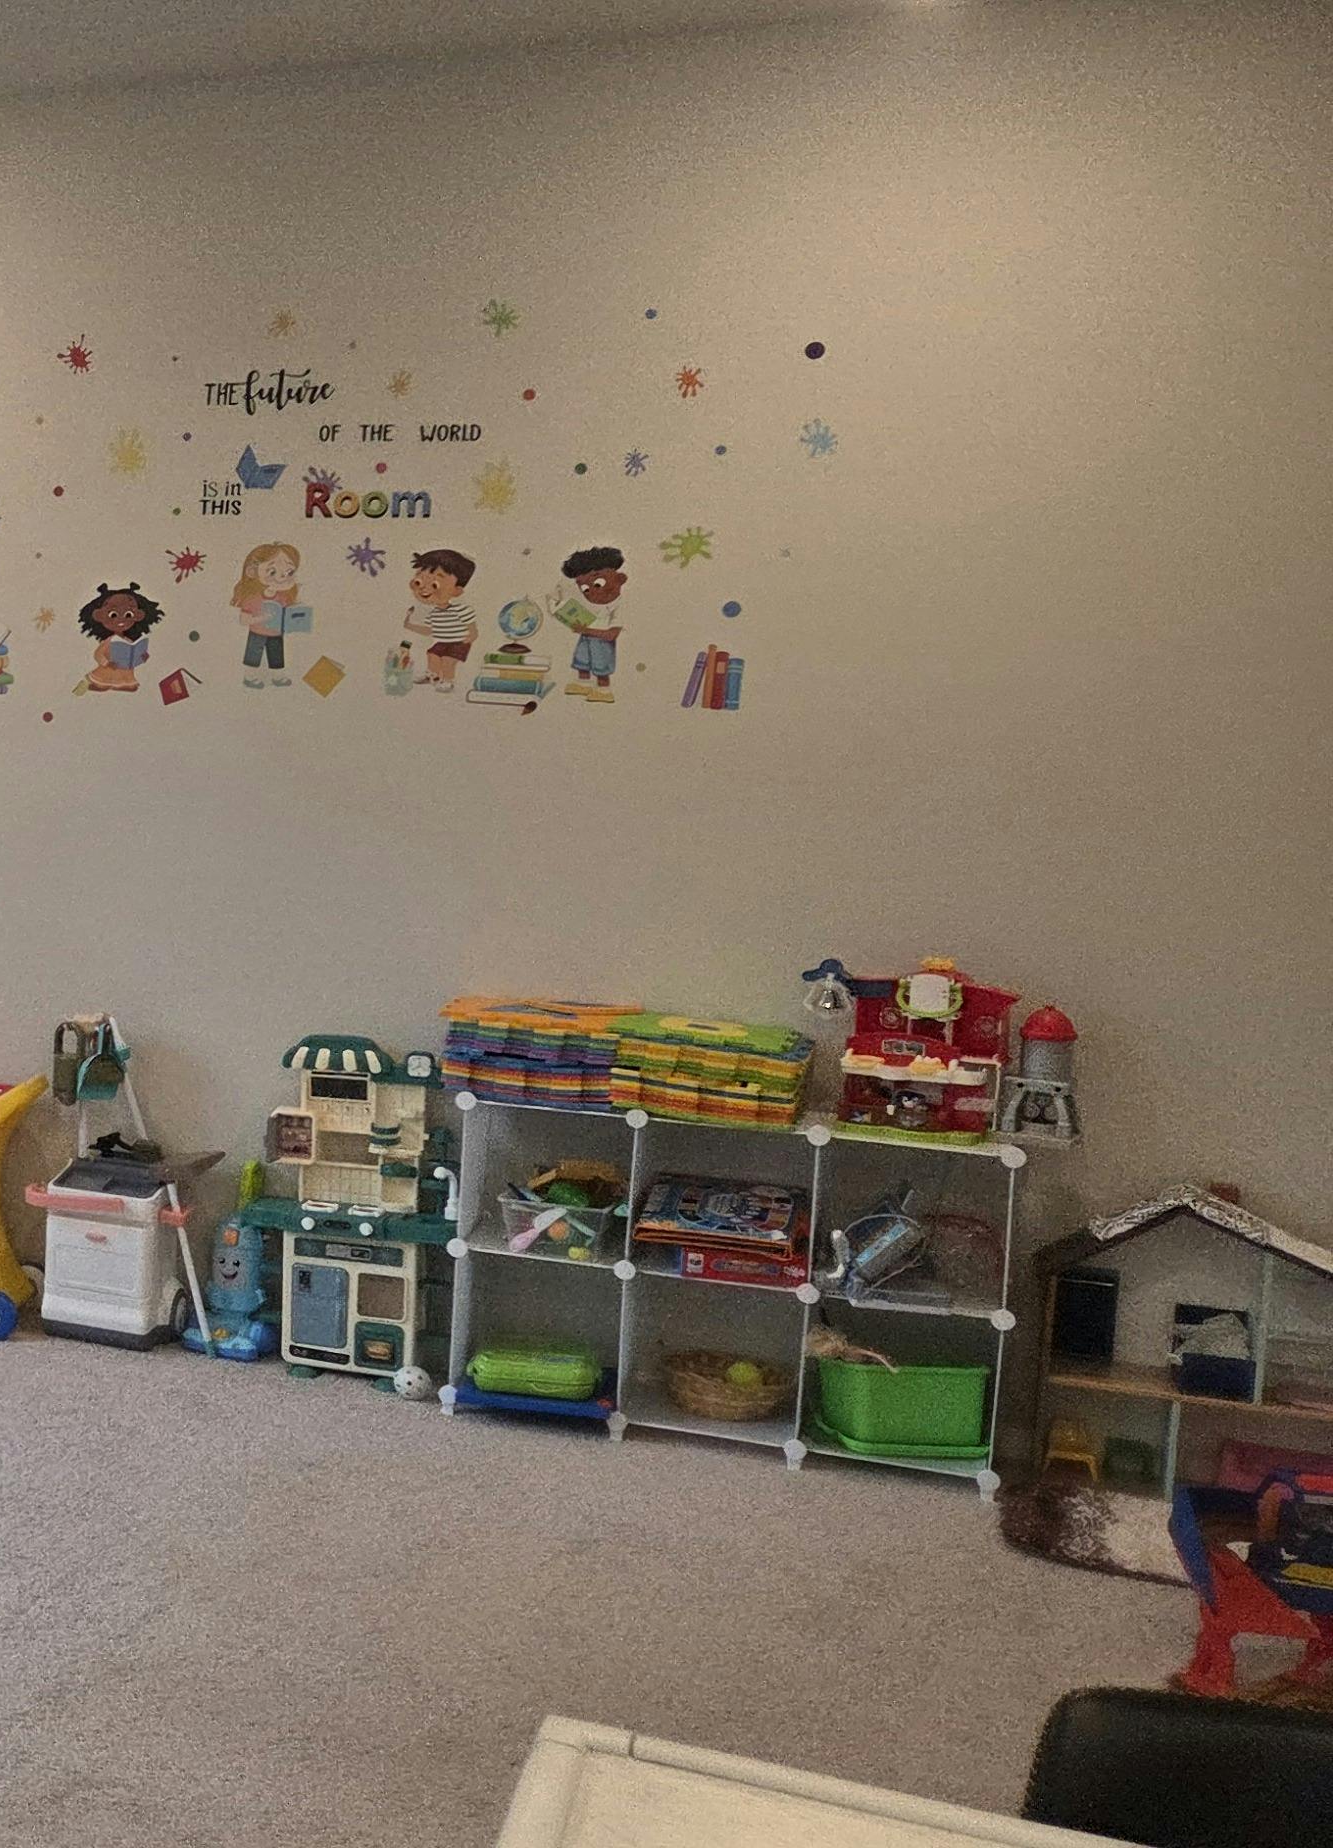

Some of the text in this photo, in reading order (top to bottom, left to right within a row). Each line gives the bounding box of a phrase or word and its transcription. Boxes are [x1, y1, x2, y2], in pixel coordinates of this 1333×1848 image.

[205, 368, 334, 416] THE future
[318, 423, 482, 442] OF THE WORLD
[202, 478, 241, 498] is in
[198, 500, 242, 516] THIS
[304, 481, 432, 518] Room
